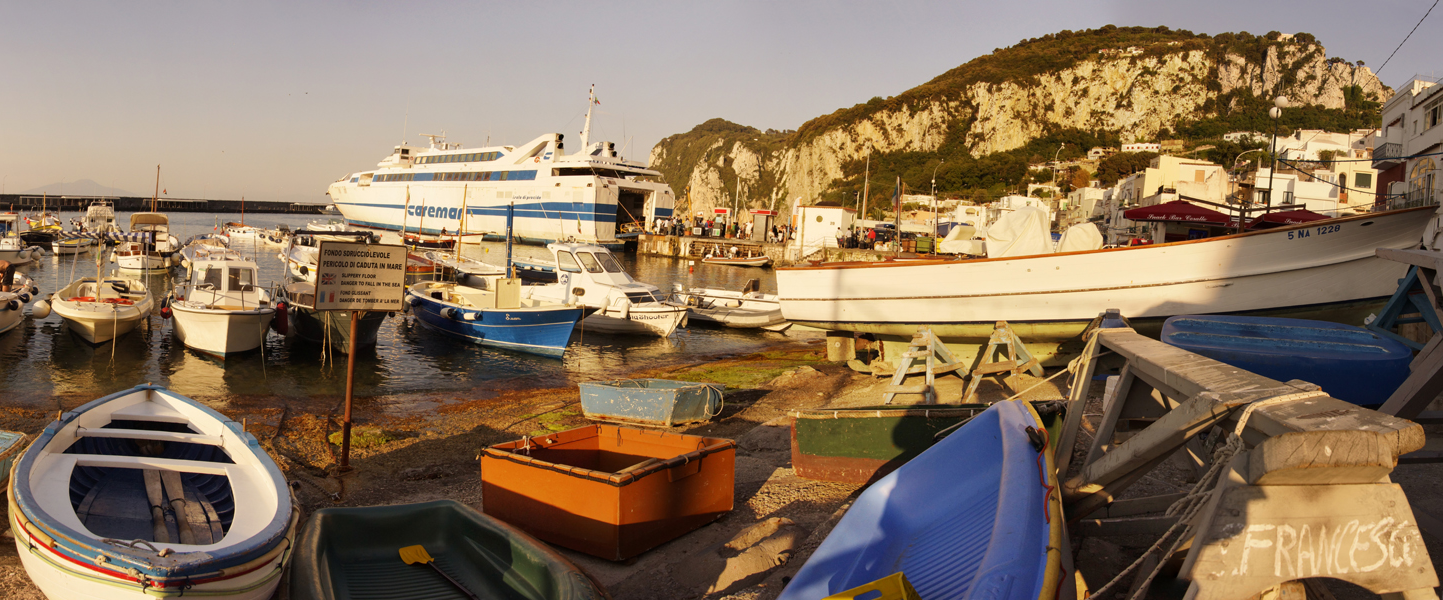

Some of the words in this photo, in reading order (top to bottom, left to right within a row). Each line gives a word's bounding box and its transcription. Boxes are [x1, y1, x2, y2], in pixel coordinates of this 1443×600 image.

[1287, 232, 1294, 240] 5
[1298, 229, 1310, 239] NA
[1316, 224, 1341, 236] 1228
[343, 250, 390, 258] SDRUCCIOLEVOLE
[1240, 516, 1420, 578] FRANCESCO
